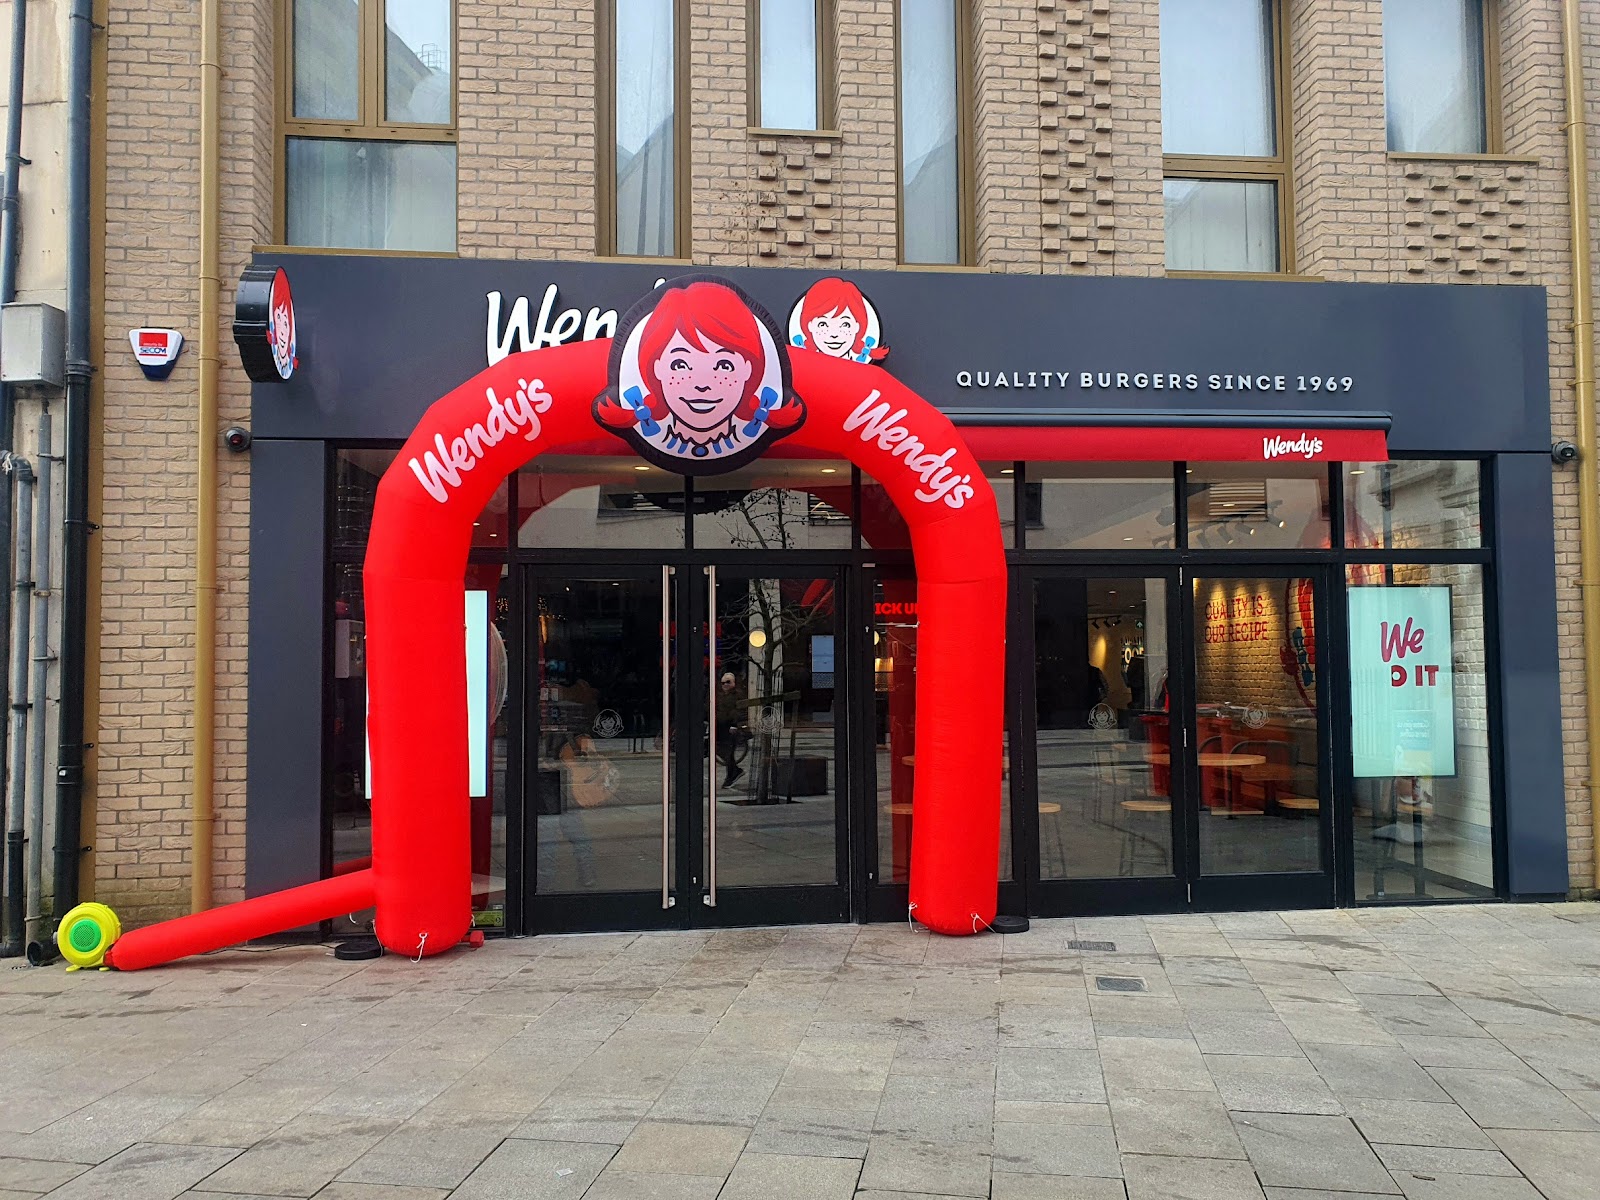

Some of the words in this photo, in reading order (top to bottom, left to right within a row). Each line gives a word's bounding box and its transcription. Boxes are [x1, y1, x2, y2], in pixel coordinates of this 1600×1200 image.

[486, 278, 666, 367] Wen
[956, 371, 1070, 388] QUALITY
[1080, 372, 1199, 390] BURGERS
[1208, 374, 1286, 391] SINCE
[1296, 376, 1353, 392] 1969
[408, 378, 553, 503] Wendy's
[843, 389, 974, 509] Wendy's
[1263, 433, 1323, 459] Wendy's
[874, 602, 902, 615] ICK
[904, 602, 918, 615] U
[1204, 598, 1249, 620] QUALITY
[1251, 595, 1263, 616] IS
[1204, 625, 1225, 643] OUR
[1228, 621, 1269, 642] RECIPE
[1380, 616, 1425, 662] We
[1415, 664, 1440, 687] IT
